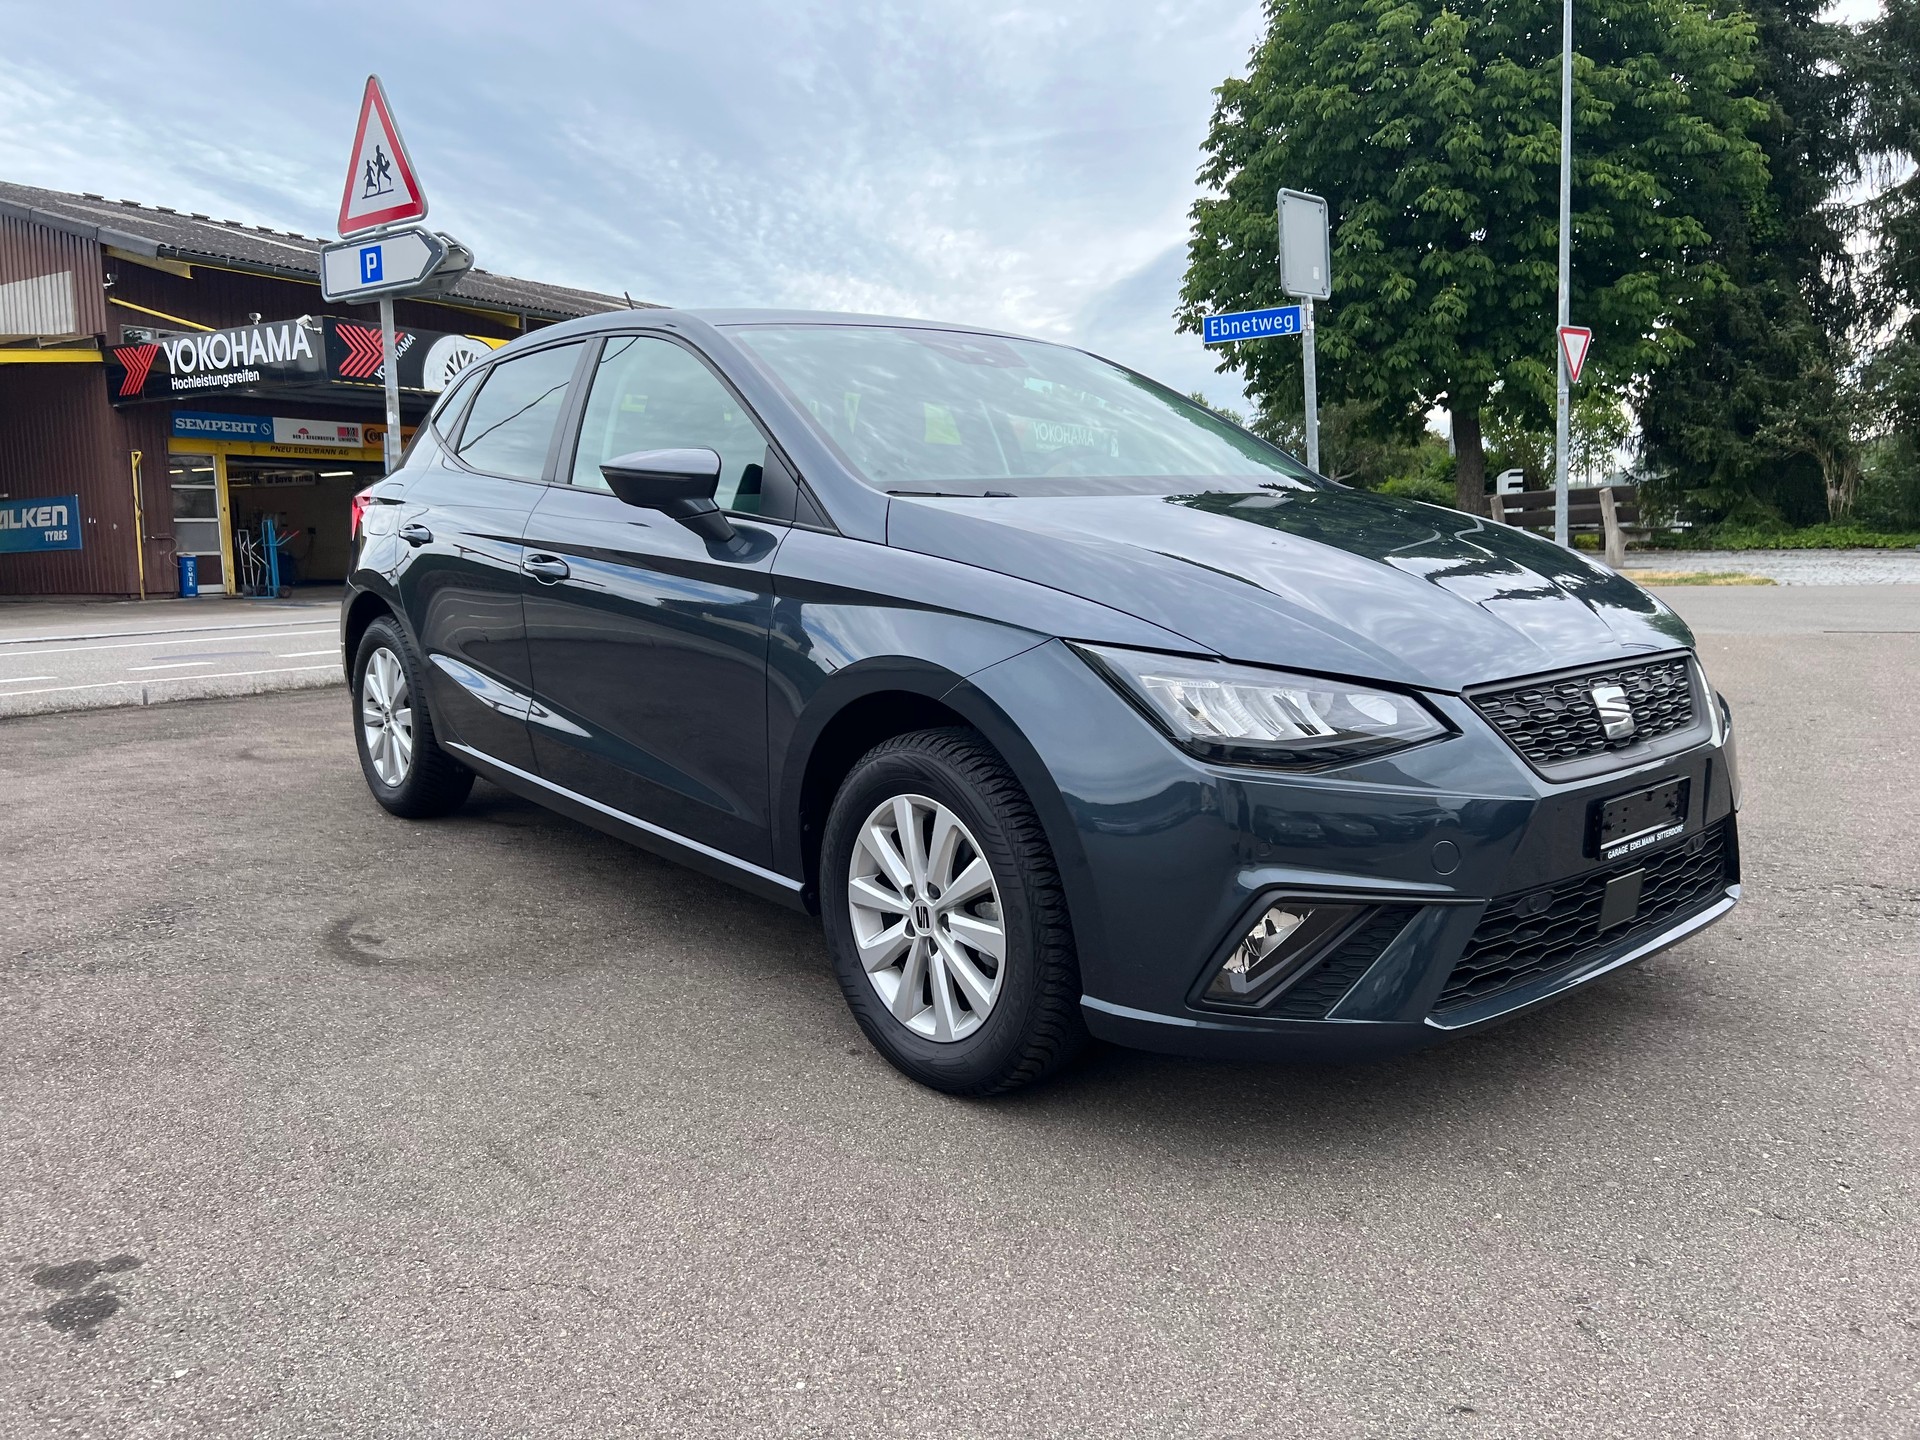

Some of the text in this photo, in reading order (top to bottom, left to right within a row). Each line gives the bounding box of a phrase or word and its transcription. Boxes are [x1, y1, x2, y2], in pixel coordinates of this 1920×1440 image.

[365, 252, 378, 279] P
[1210, 314, 1294, 337] Ebnetweg
[162, 325, 313, 375] YOKOHAMA
[374, 333, 417, 380] YOHAMA
[171, 369, 260, 390] Hochleistungsreifen
[175, 418, 258, 434] SEMPERIT
[270, 445, 291, 453] PNEU
[294, 446, 337, 455] EDELMANN
[0, 505, 68, 529] ALKEN
[44, 530, 68, 542] TYRES
[1607, 824, 1684, 859] GARAGE EDELMANN SITTERDORF
